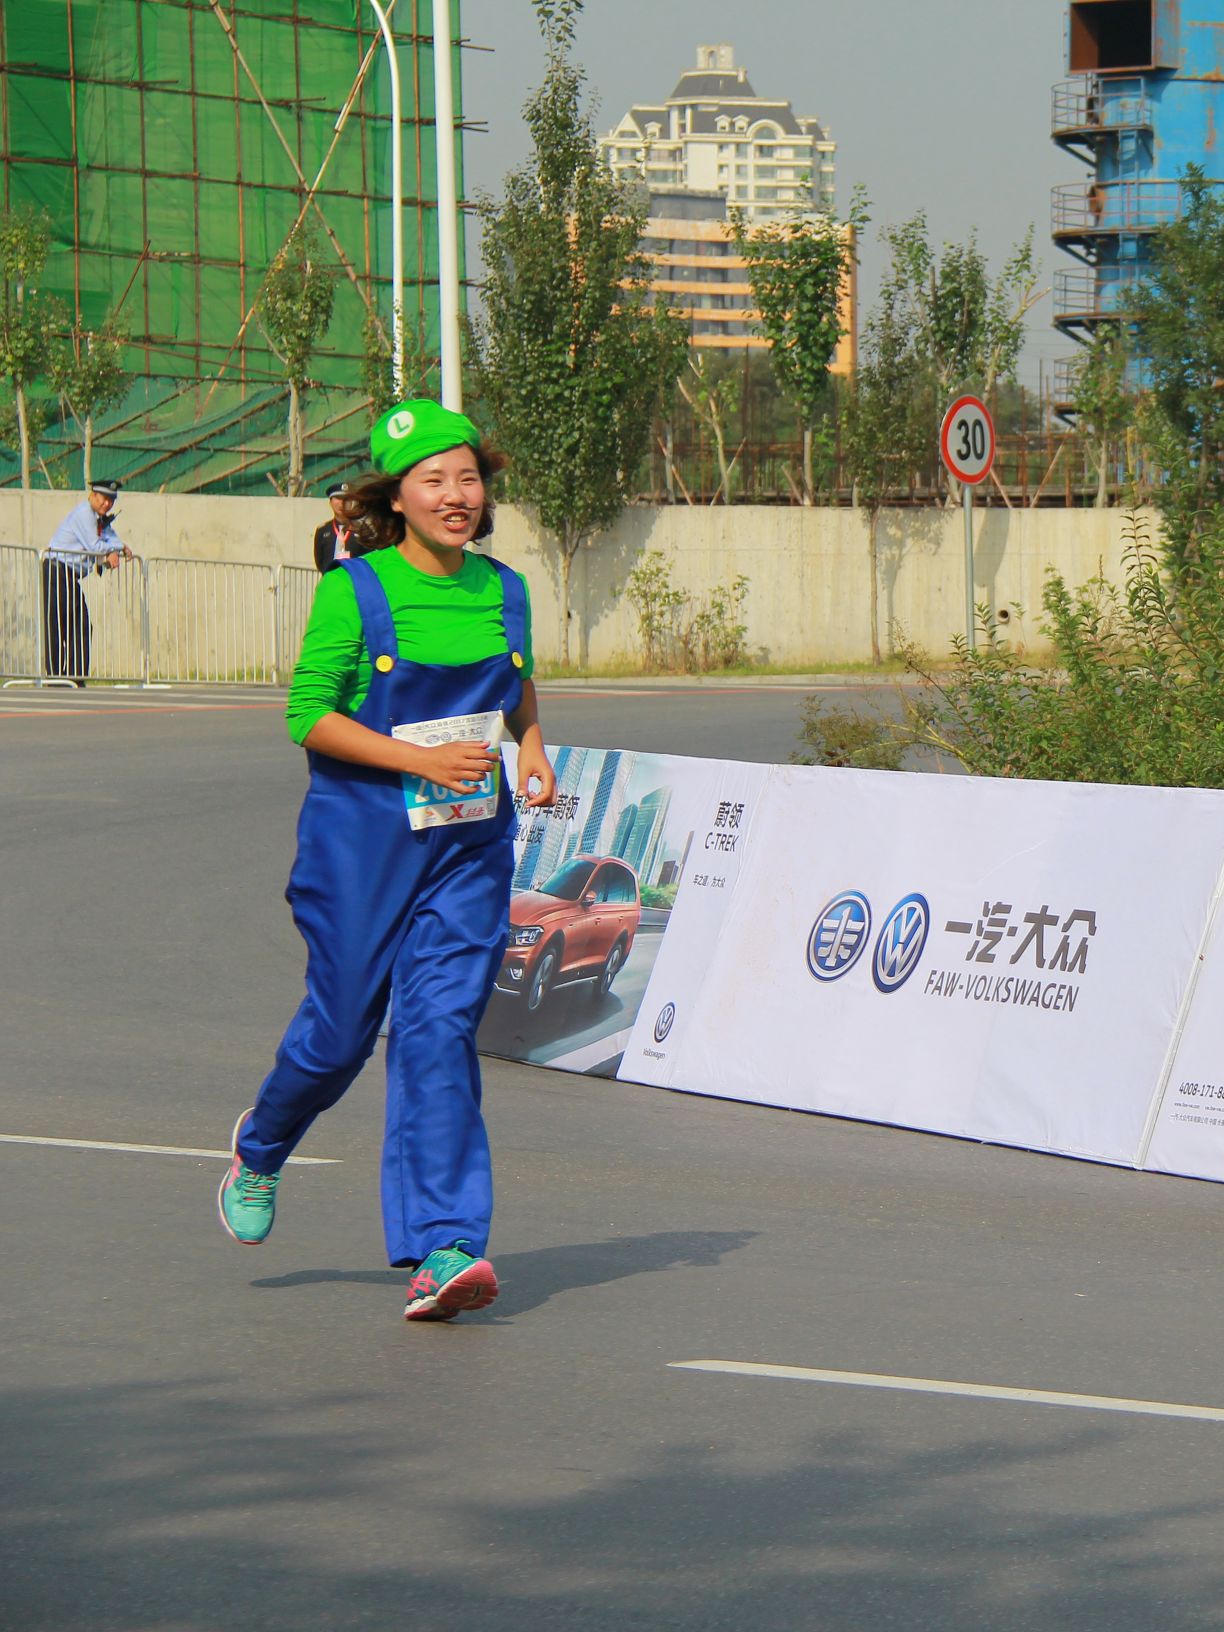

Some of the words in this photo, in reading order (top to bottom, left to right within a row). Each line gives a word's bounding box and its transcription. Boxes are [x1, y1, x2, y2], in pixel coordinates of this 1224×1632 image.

[393, 417, 410, 433] L
[956, 419, 985, 460] 30
[714, 800, 744, 829] 蔚领
[704, 832, 738, 853] C-TREK
[924, 969, 1080, 1012] FAW-VOLKSWAGEN
